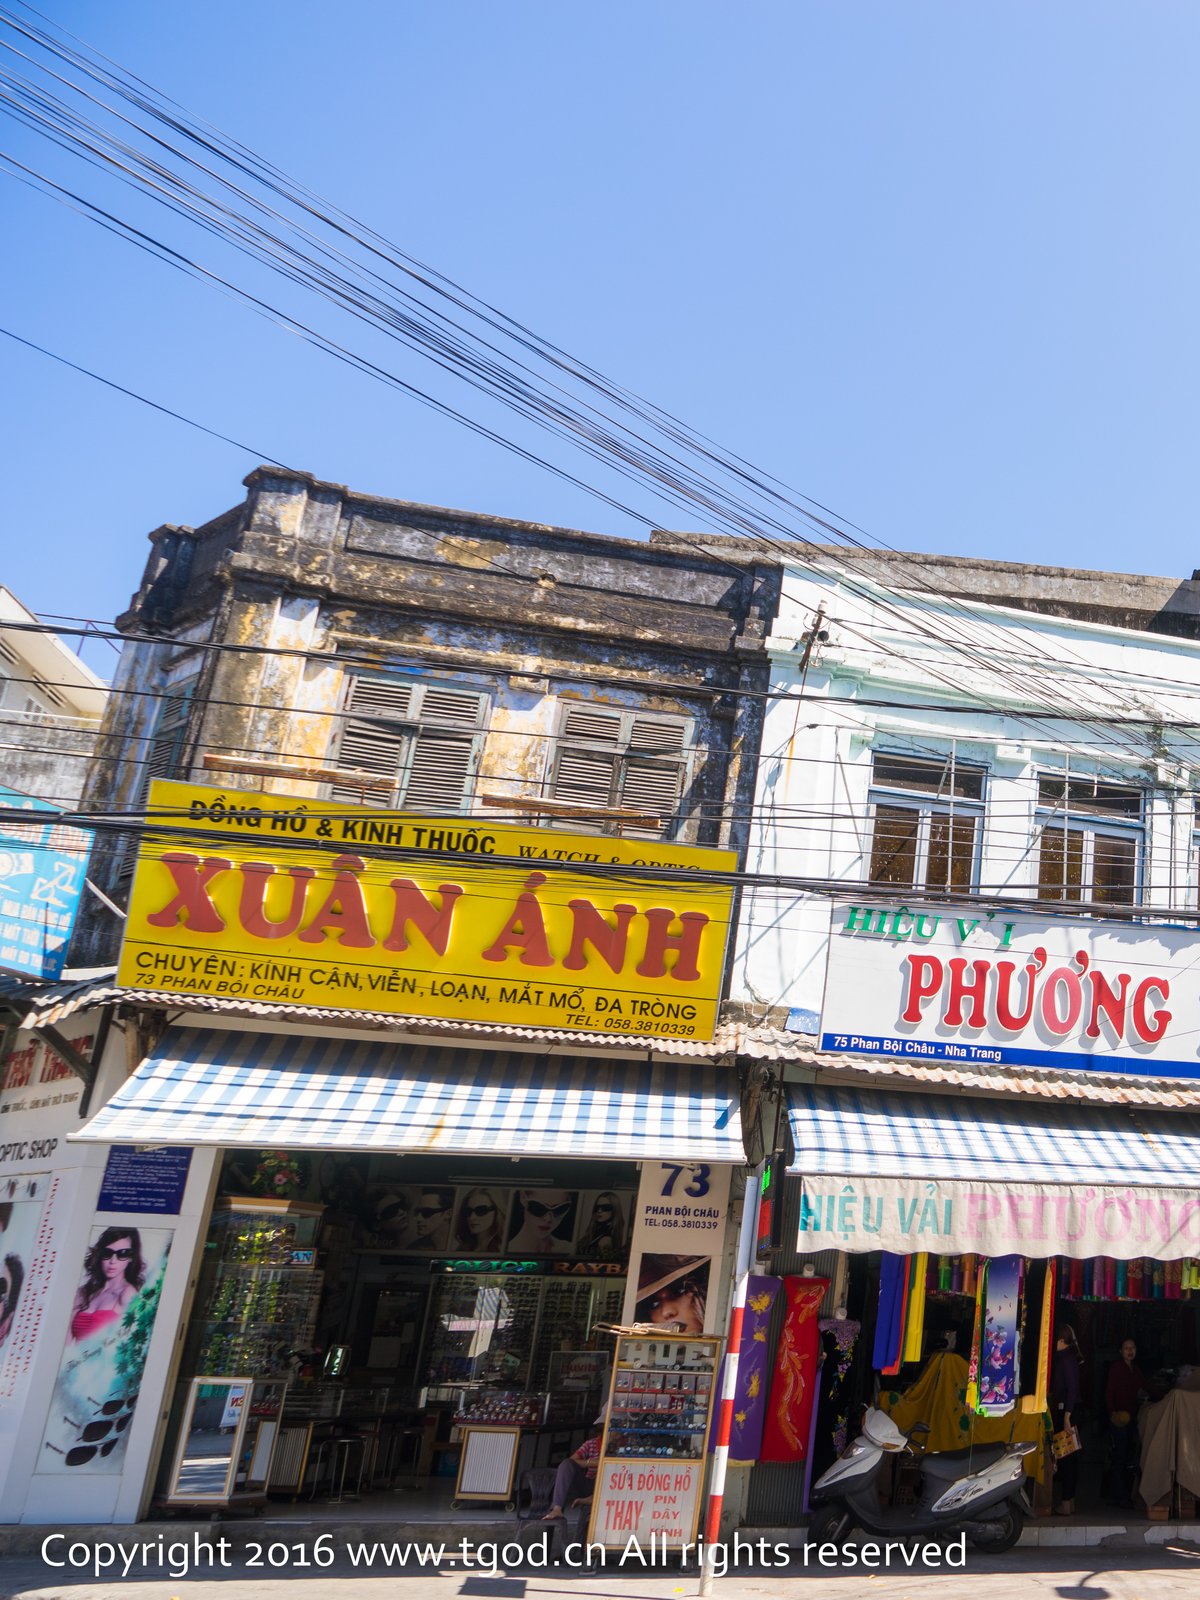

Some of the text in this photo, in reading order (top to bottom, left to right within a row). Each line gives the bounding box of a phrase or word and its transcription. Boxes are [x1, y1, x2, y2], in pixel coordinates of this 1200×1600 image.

[271, 804, 308, 833] HỒ
[315, 818, 333, 837] &
[342, 815, 403, 845] KÍNH
[412, 827, 496, 855] THUỐC
[146, 853, 710, 982] XUÂN ÁNH
[843, 906, 1016, 946] HIỆU VI
[135, 973, 305, 1000] 73 PHAN BỘI CHÂU
[250, 959, 302, 983] KÍNH
[431, 980, 490, 1003] LOẠN,
[499, 982, 543, 1006] MẮT
[549, 987, 585, 1012] MỔ,
[595, 996, 622, 1014] ĐA
[630, 998, 697, 1020] TRÒNG
[903, 945, 1172, 1044] PHƯƠNG
[565, 1013, 695, 1036] TEL: 058.3810339
[834, 1036, 1002, 1062] 75 Phan Bội Châu Nha Trang
[29, 1138, 58, 1160] SHOP
[660, 1162, 711, 1198] 73
[645, 1206, 719, 1219] PHAN BỘI CHÂU
[799, 1185, 882, 1240] HIỆU
[897, 1184, 953, 1236] VẢI
[553, 1261, 628, 1274] RAYB
[637, 1465, 671, 1492] ĐỒNG
[673, 1466, 692, 1492] HỒ
[654, 1495, 677, 1505] PIN
[605, 1500, 645, 1531] THAY
[652, 1508, 680, 1520] DÂY
